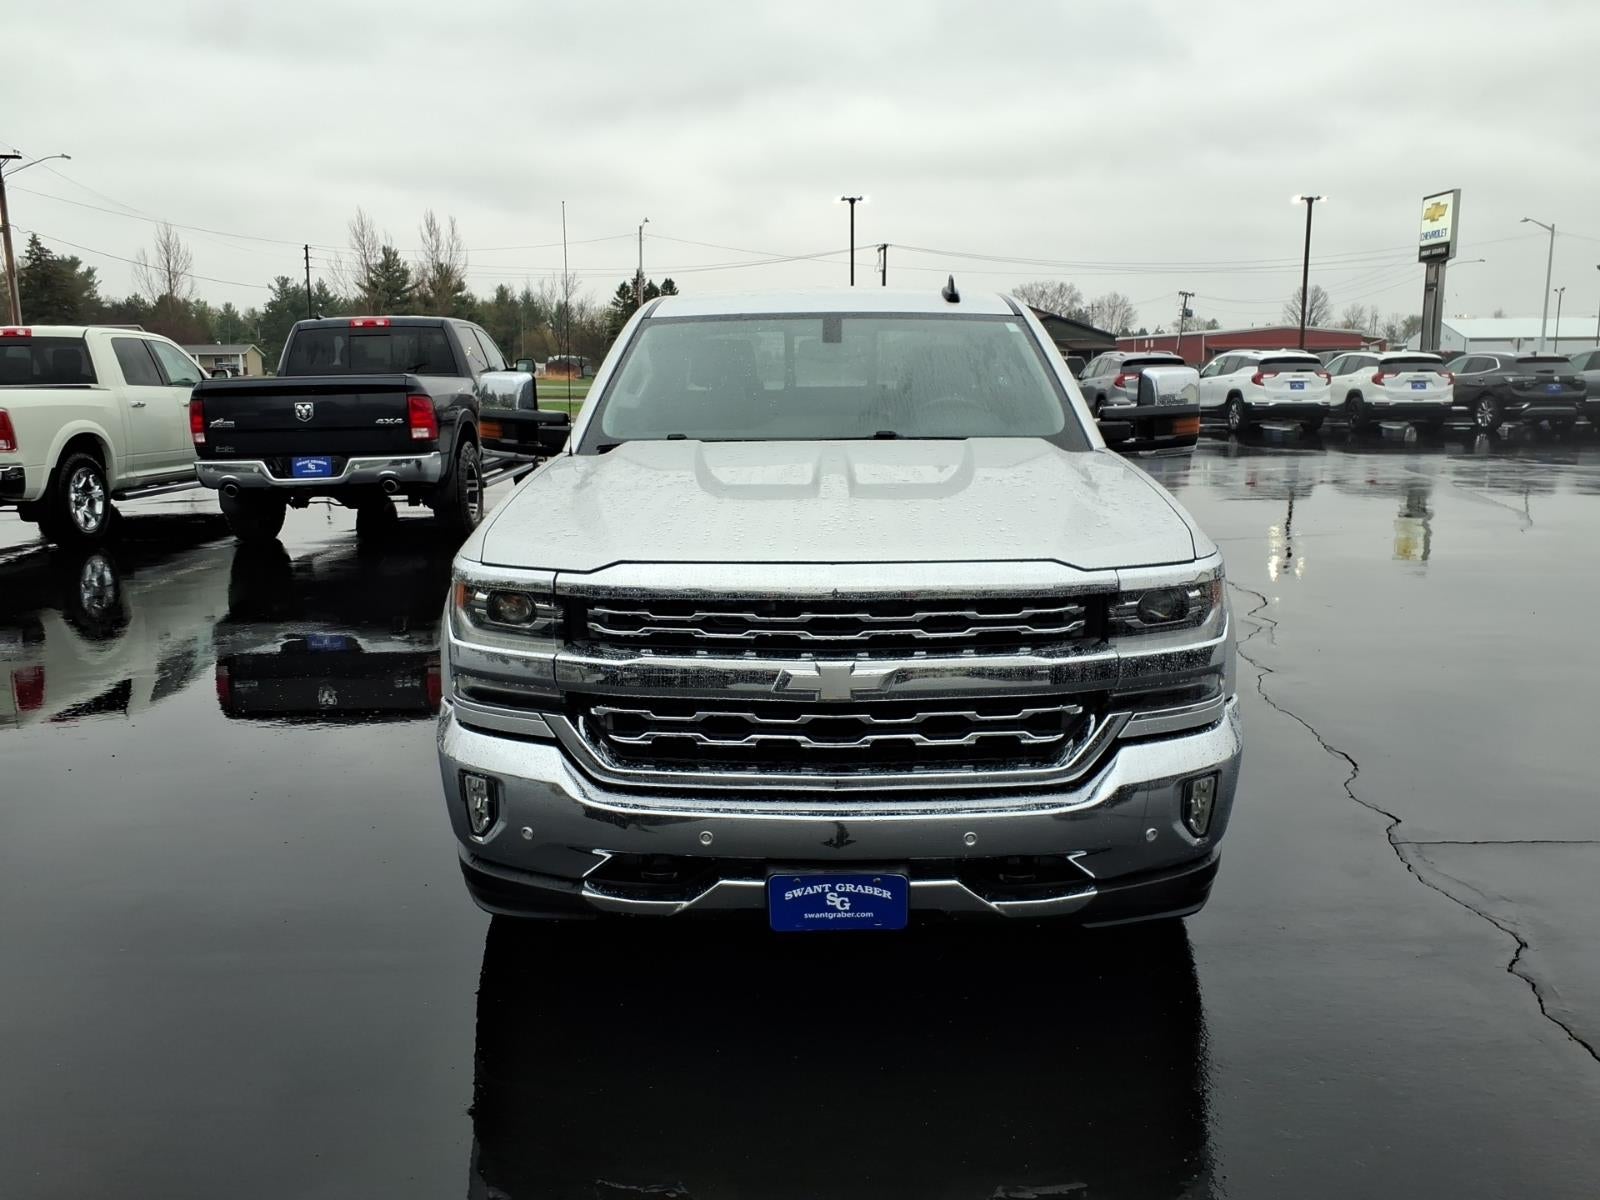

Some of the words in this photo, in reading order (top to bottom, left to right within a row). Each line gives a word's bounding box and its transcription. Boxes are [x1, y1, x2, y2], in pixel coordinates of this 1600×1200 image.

[1420, 228, 1448, 241] CHEVROLET
[784, 883, 832, 901] SWANT
[835, 883, 892, 900] GRABER
[826, 892, 851, 911] SG
[804, 911, 874, 920] swantgraber.com
